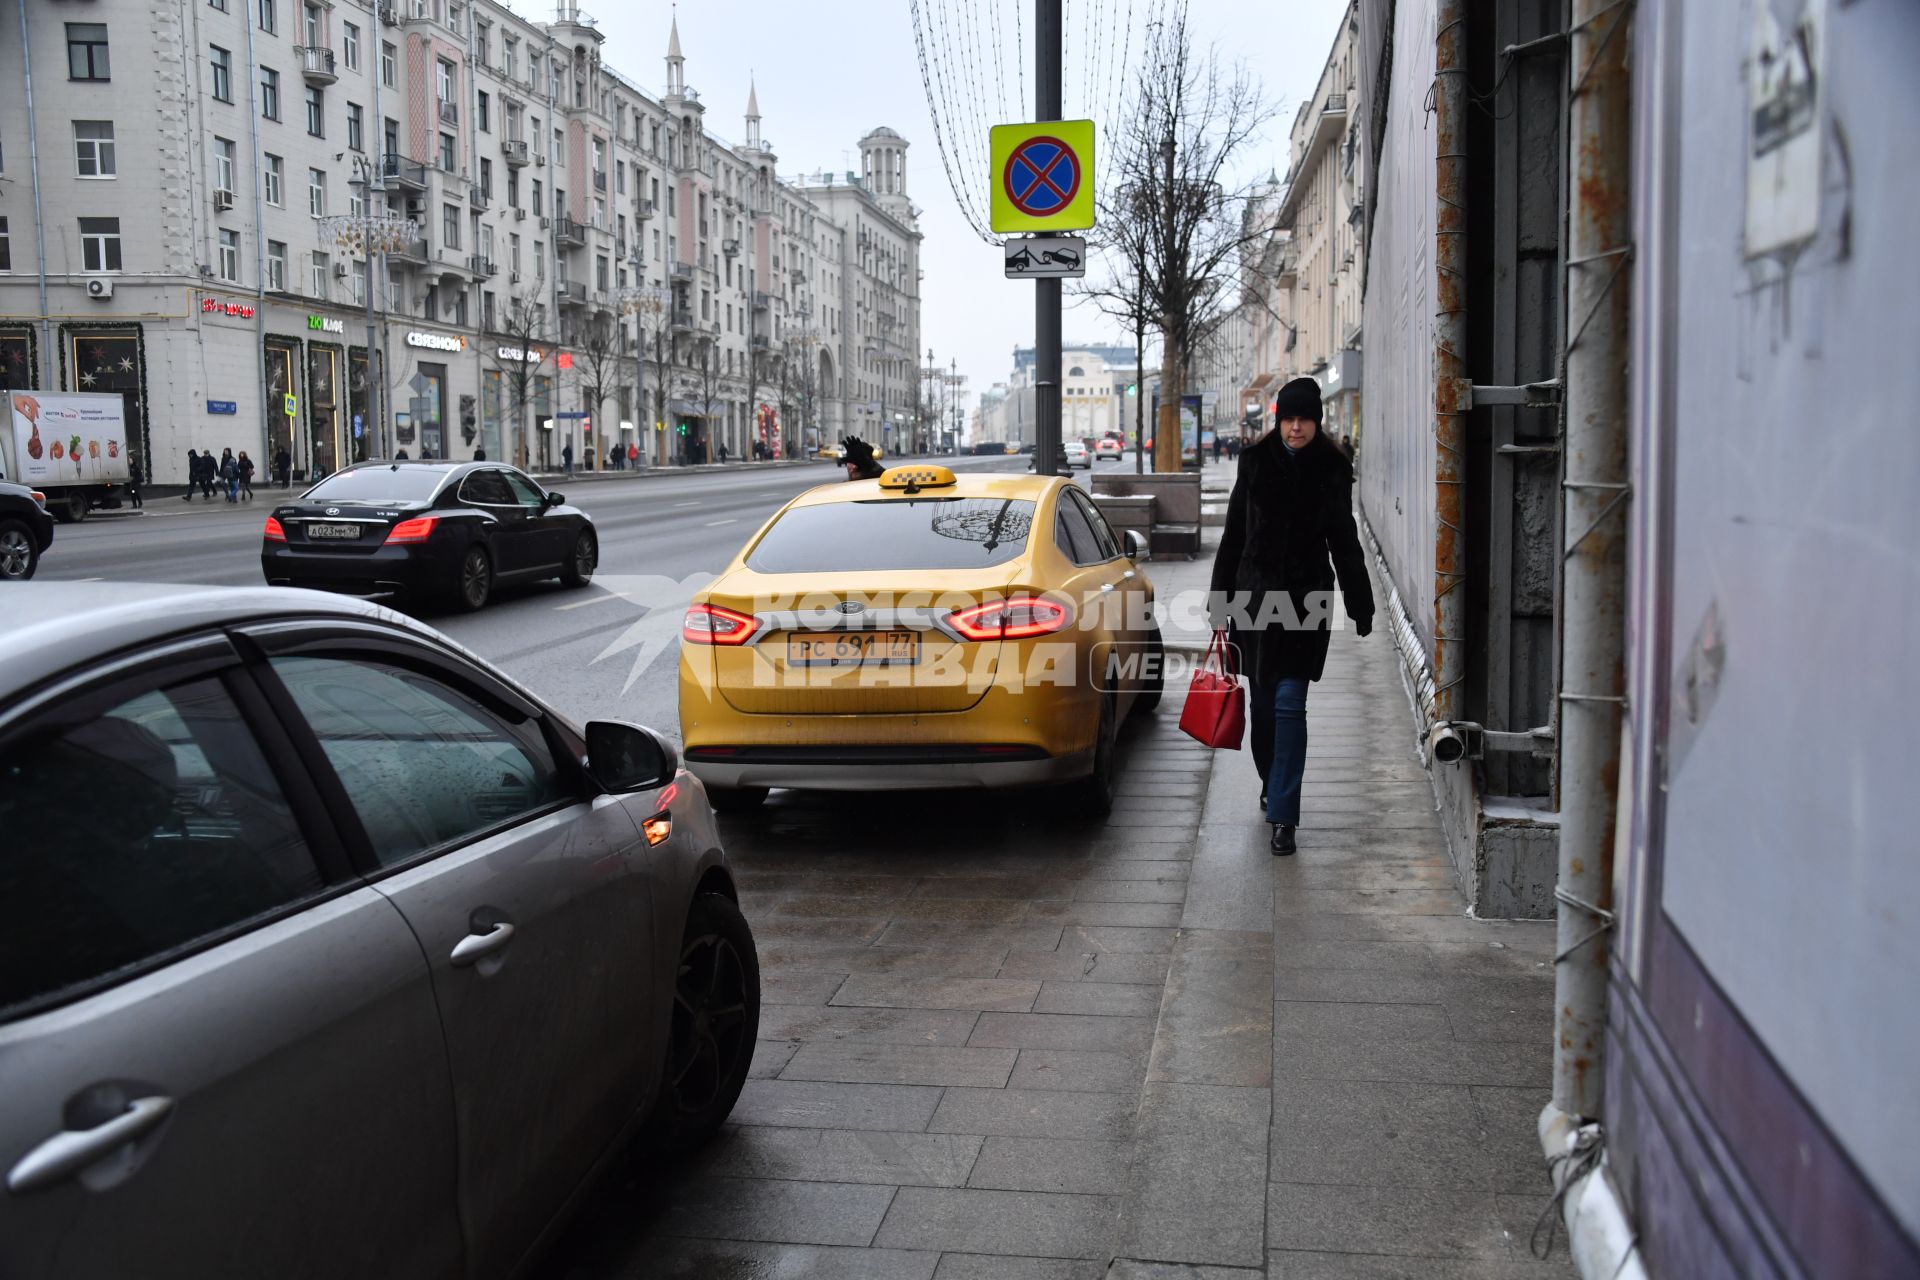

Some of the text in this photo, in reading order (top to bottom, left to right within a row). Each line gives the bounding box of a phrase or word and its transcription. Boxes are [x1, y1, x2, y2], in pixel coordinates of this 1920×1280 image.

[322, 318, 344, 334] КАФЕ
[406, 331, 462, 352] СВЯЗНОЙ
[835, 634, 876, 657] 691
[889, 633, 911, 650] 77
